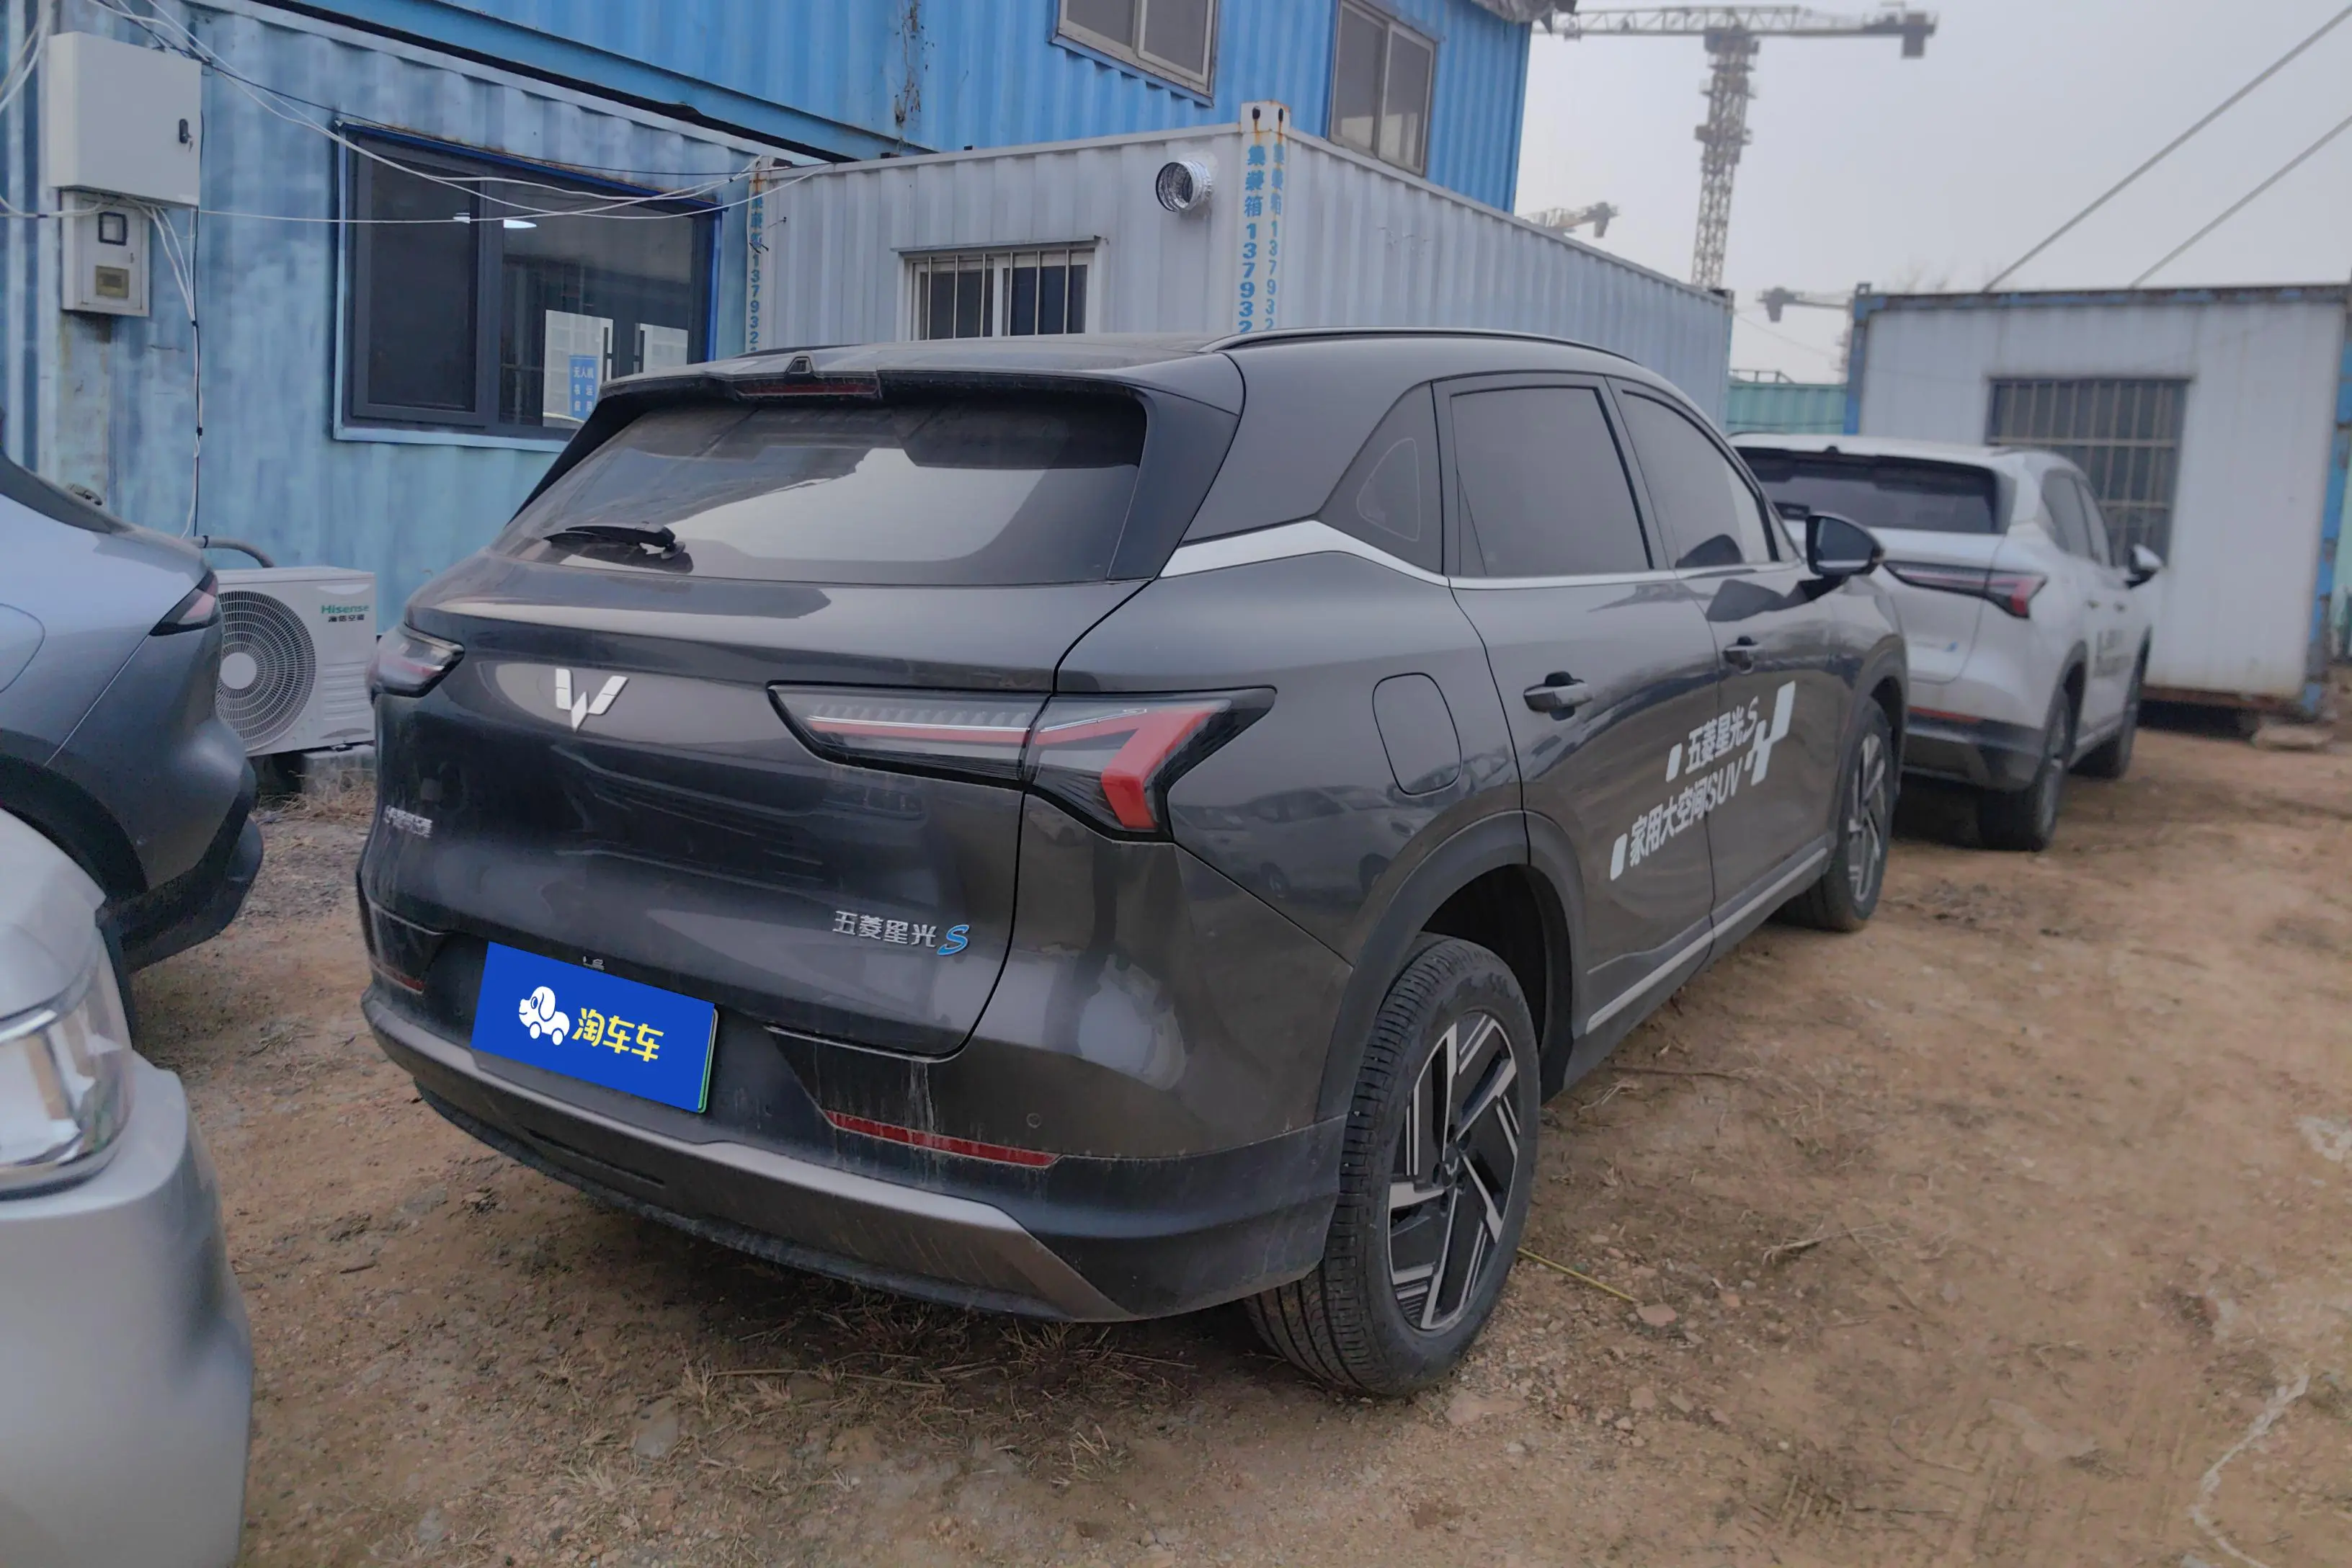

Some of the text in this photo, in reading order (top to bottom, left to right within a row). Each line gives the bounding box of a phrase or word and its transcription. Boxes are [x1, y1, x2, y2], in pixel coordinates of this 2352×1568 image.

[321, 605, 369, 614] Hisense
[1629, 755, 1744, 868] 家用大空间SUV
